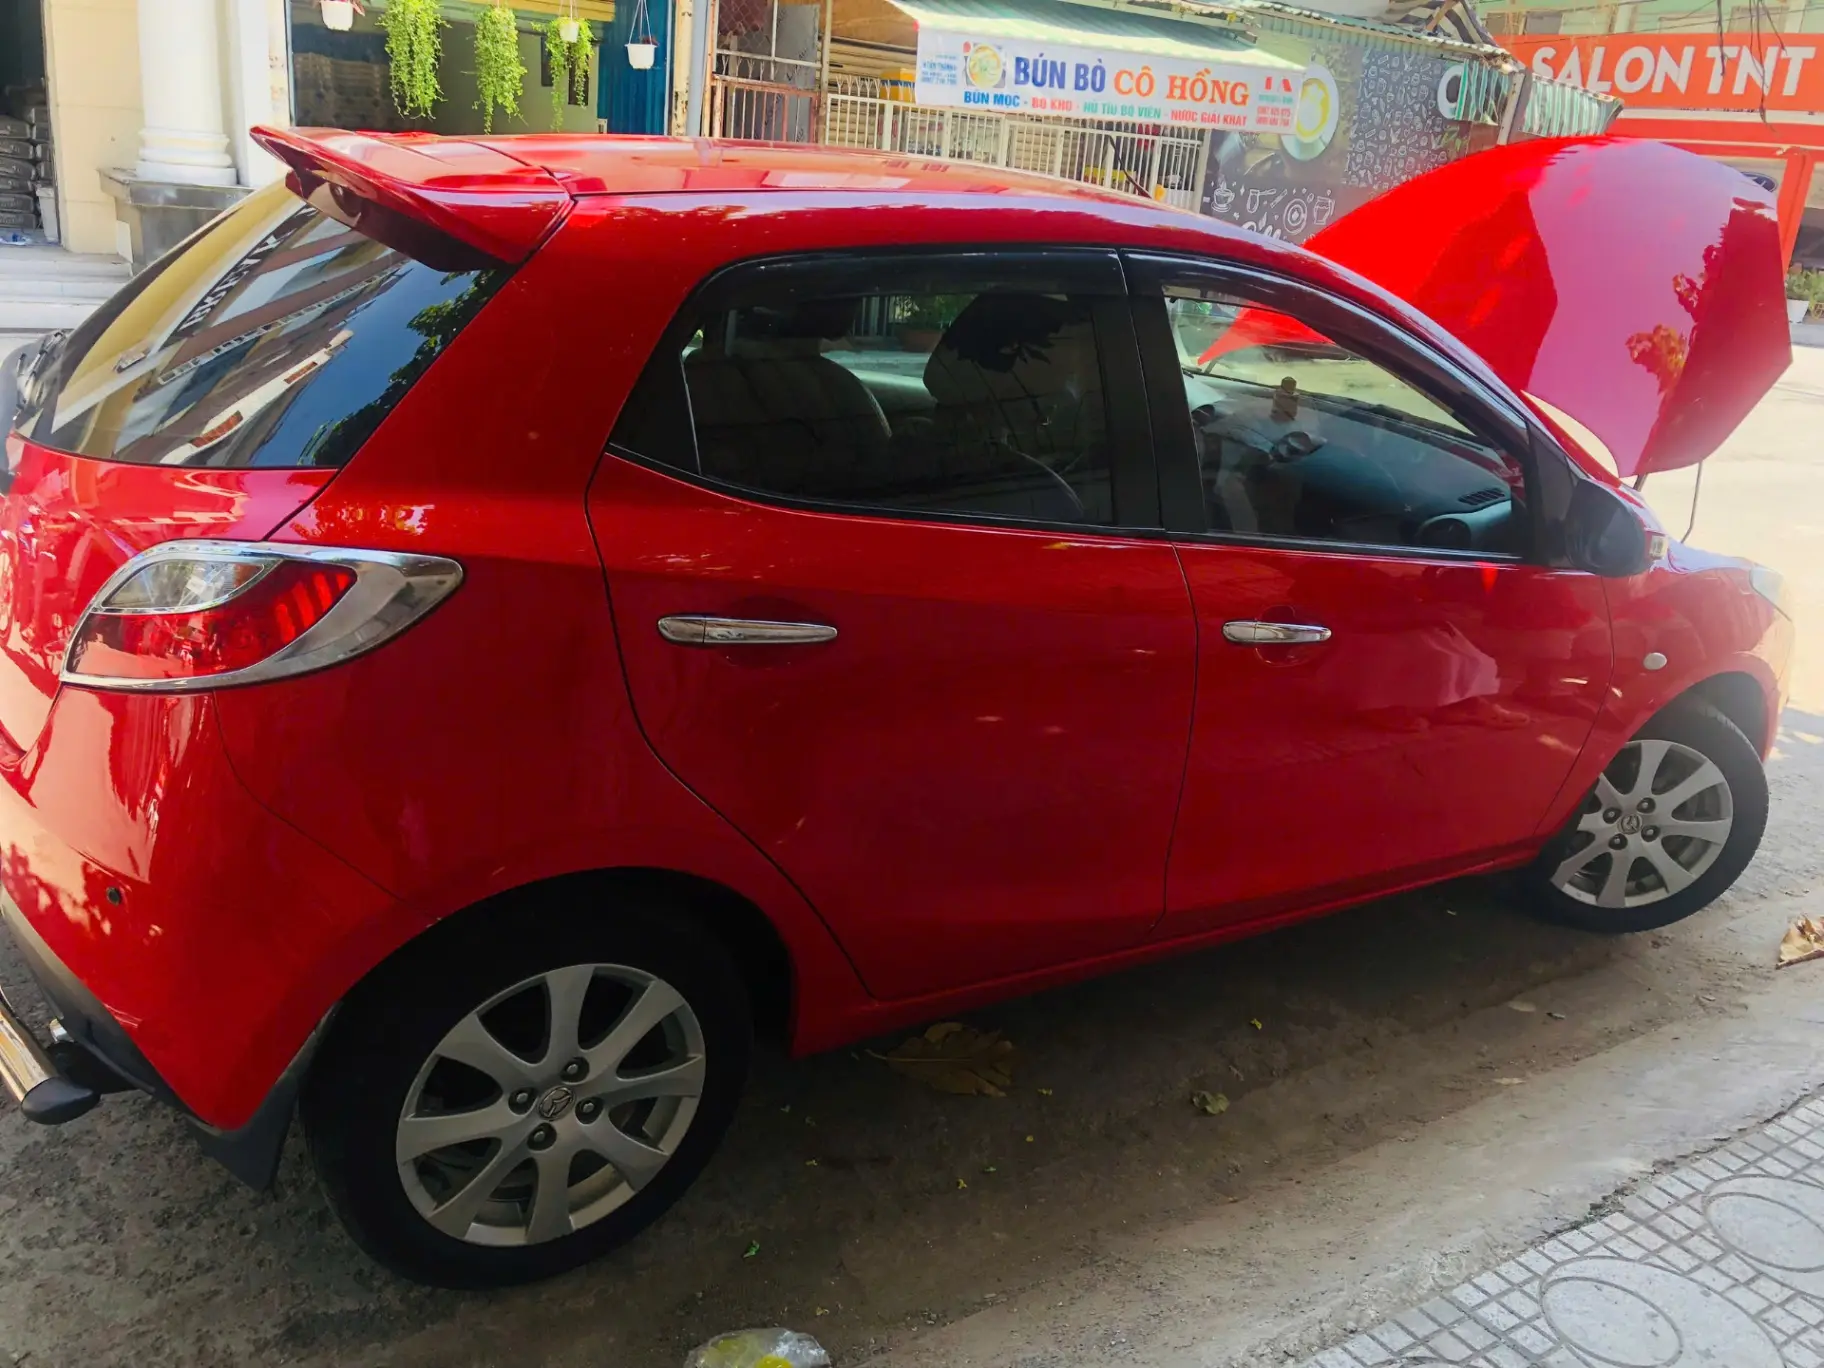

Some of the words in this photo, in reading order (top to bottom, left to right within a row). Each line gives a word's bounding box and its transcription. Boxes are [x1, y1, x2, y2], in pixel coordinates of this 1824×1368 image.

[1014, 53, 1066, 89] BÚN
[1074, 58, 1107, 93] BÒ
[1114, 65, 1155, 97] CÔ
[1166, 68, 1250, 106] HỒNG
[1532, 46, 1695, 94] SALON
[1706, 46, 1816, 96] TNT
